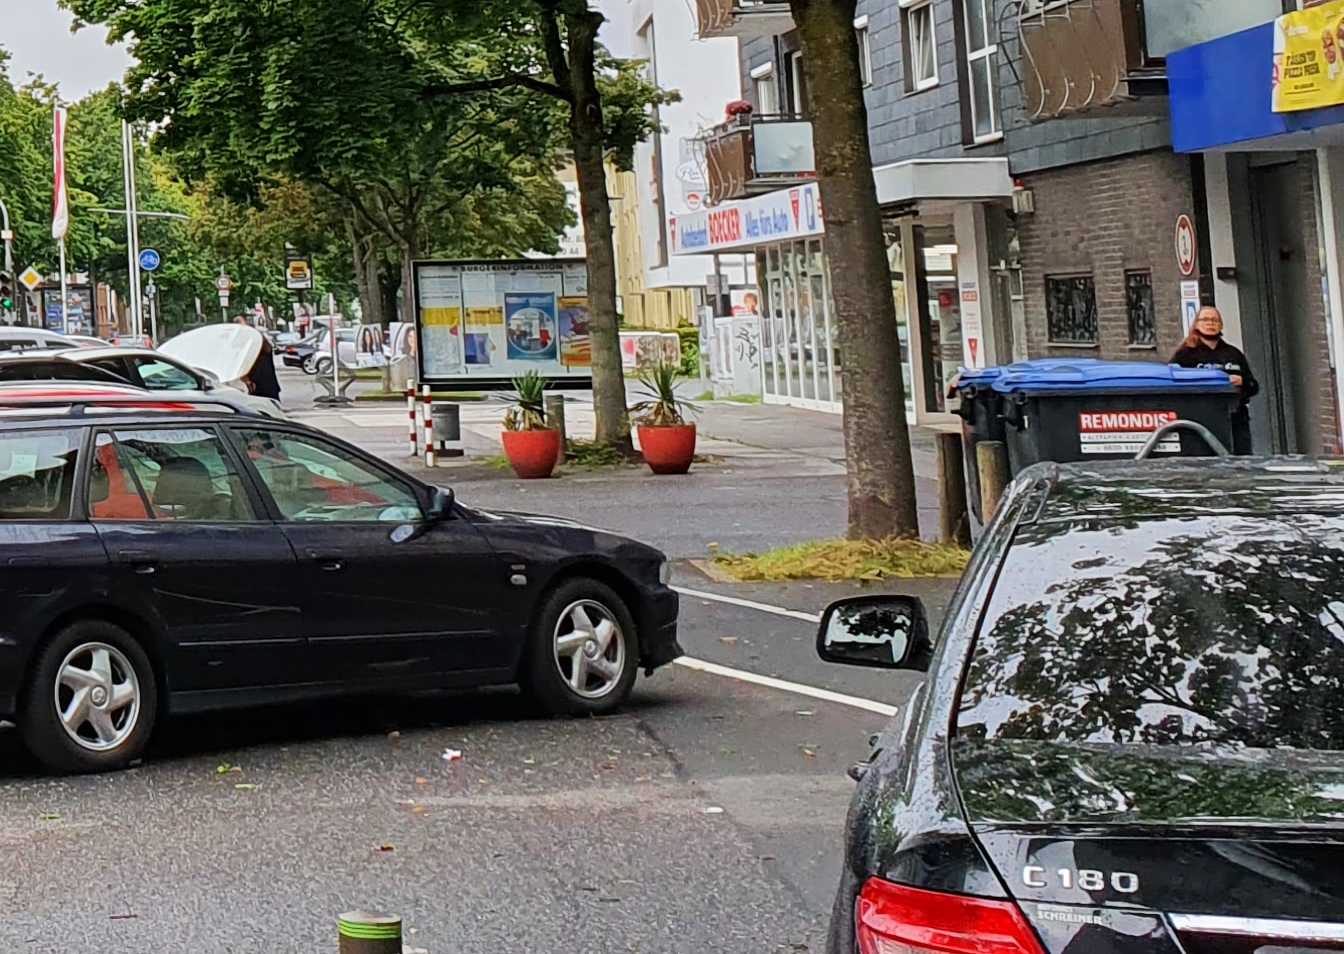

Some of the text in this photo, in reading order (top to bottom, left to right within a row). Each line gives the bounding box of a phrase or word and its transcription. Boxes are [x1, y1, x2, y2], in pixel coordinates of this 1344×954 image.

[708, 208, 742, 244] BOECKER
[1081, 413, 1170, 429] REMONDIS
[1023, 866, 1140, 893] C 180
[1037, 911, 1103, 924] SCHREINER
